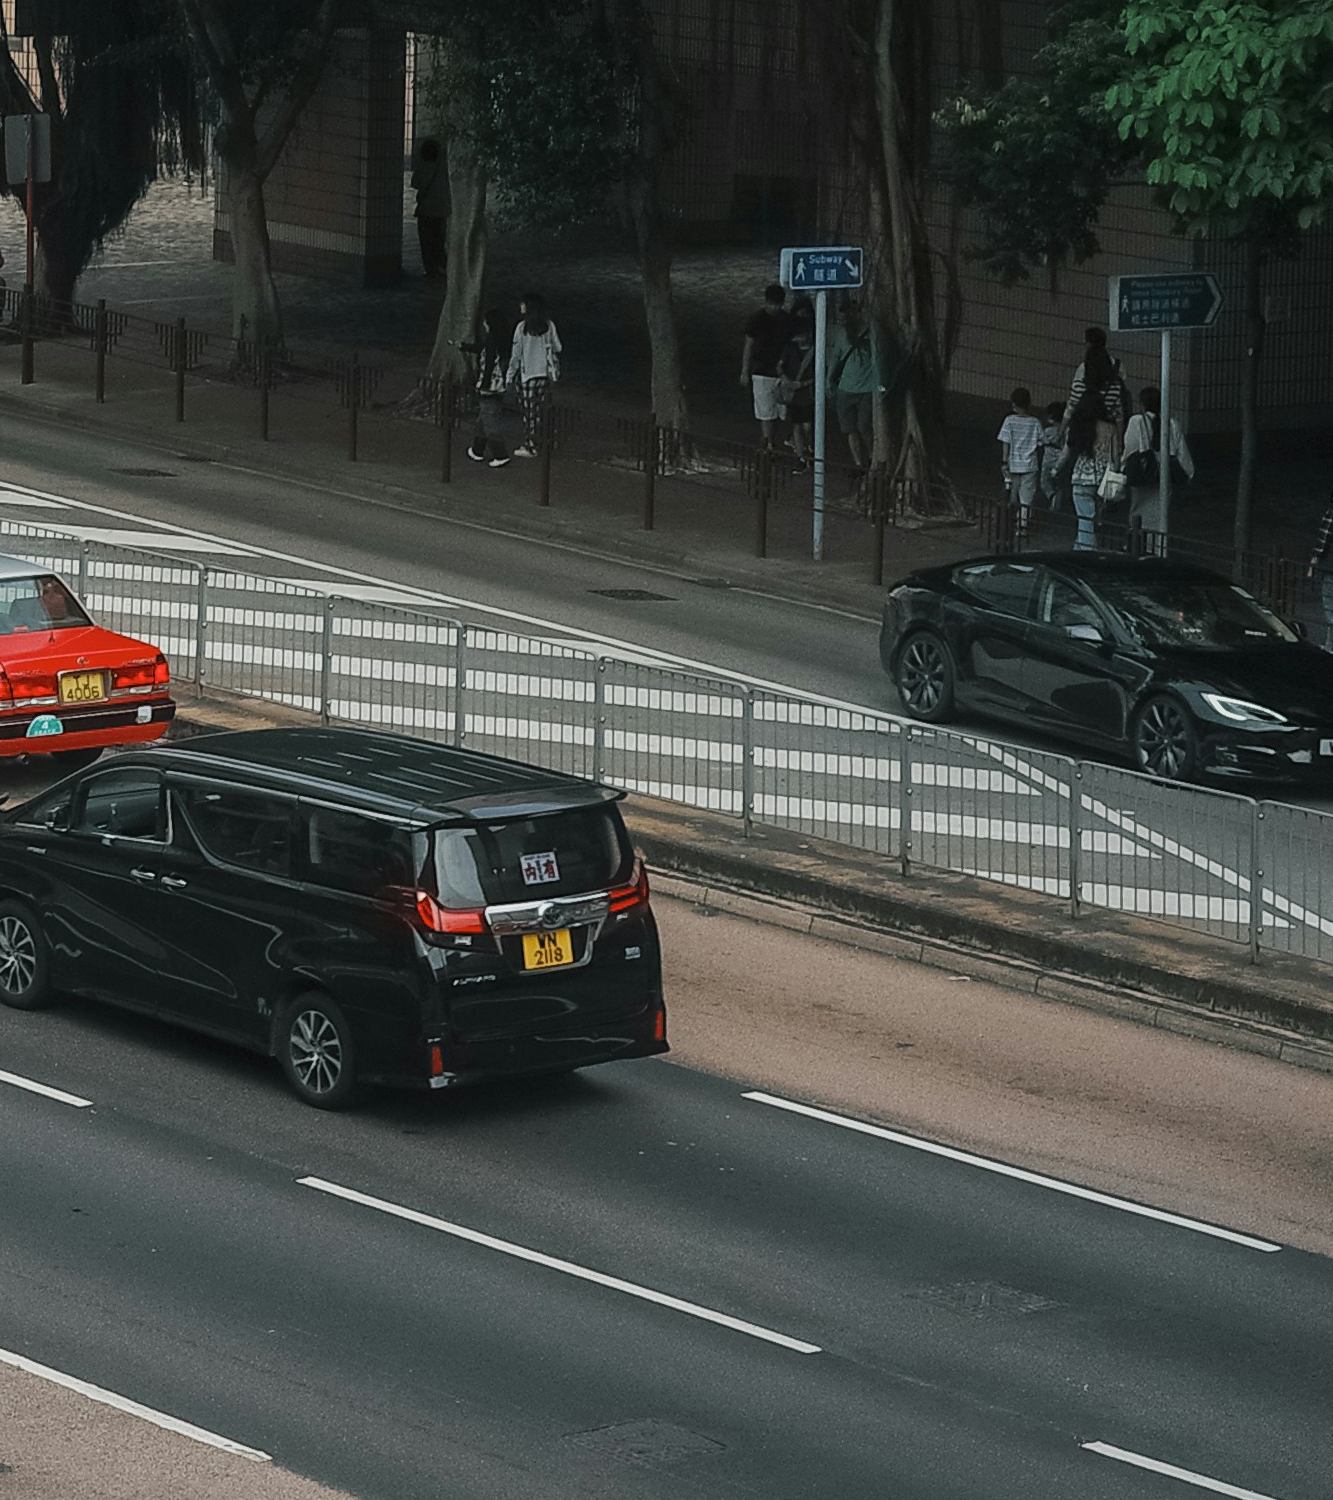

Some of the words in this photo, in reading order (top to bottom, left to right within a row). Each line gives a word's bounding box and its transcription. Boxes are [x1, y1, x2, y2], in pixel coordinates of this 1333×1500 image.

[808, 255, 843, 265] Subway
[41, 721, 49, 730] 4
[534, 948, 564, 965] 2118
